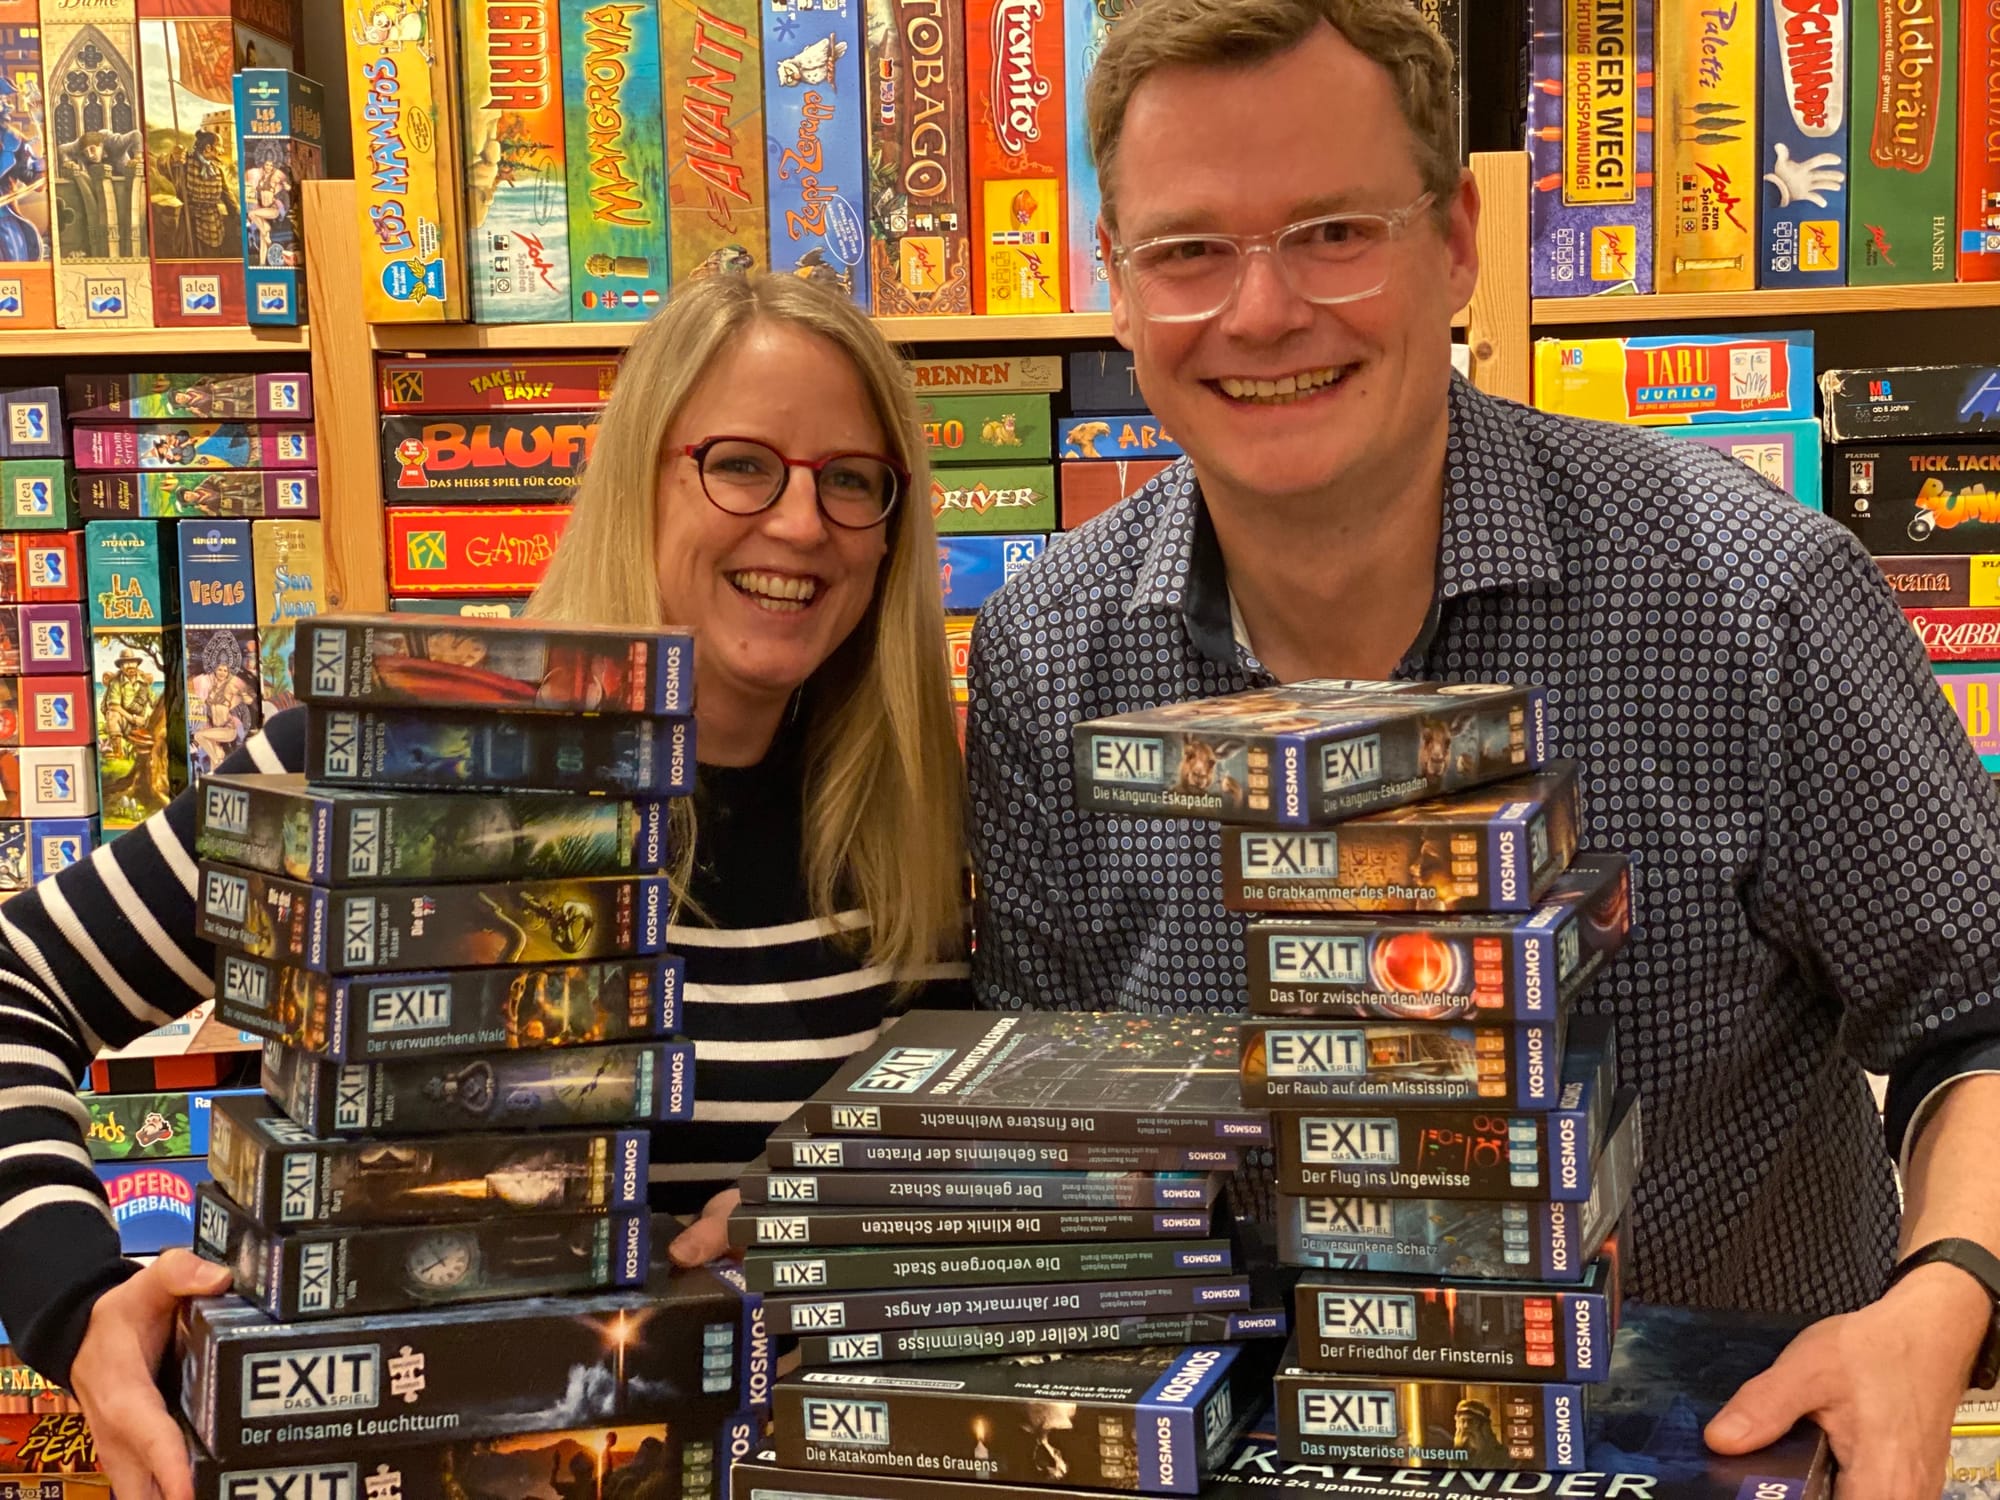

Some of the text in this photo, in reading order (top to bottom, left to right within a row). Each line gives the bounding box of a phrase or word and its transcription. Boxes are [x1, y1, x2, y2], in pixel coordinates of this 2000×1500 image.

[480, 0, 550, 109] GARA
[1700, 2, 1737, 88] Paletti
[1893, 0, 1934, 144] oldbräu
[683, 8, 752, 203] AVANTI
[1596, 0, 1623, 189] INGER WEG!
[1882, 75, 1892, 112] gewinnt
[256, 108, 275, 120] LAS
[584, 5, 650, 226] MANGROVIA
[1577, 62, 1591, 189] HOCHSPANNUNG!
[364, 57, 413, 253] LOS MAMPFOS
[779, 90, 838, 241] Zapp Zerapp
[1700, 188, 1710, 230] Spielen
[1932, 216, 1944, 271] HANSER
[91, 284, 120, 296] alea
[185, 282, 215, 293] alea
[1561, 349, 1583, 365] MB
[1644, 348, 1711, 385] TABU
[470, 369, 527, 394] TAKE IT
[915, 362, 1010, 387] RENNEN
[504, 383, 555, 401] EASY!
[1741, 389, 1786, 410] für Kinder
[1869, 381, 1891, 396] MB
[1890, 404, 1909, 412] Jahre
[18, 407, 28, 439] alea
[430, 479, 452, 488] DAS
[454, 478, 490, 487] HEISSE
[493, 478, 520, 487] SPIEL
[523, 476, 545, 486] FÜR
[1852, 463, 1862, 475] 12
[941, 487, 1036, 509] RIVER
[36, 552, 45, 583] alea
[275, 566, 313, 592] San
[112, 573, 142, 598] LA
[189, 580, 245, 606] VEGAS
[1886, 573, 1951, 591] scana
[103, 599, 153, 619] ISLA
[271, 591, 317, 624] Juan
[39, 626, 47, 656] alea
[666, 647, 680, 710] KOSMOS
[43, 696, 52, 727] alea
[671, 724, 685, 786] KOSMOS
[1096, 741, 1162, 778] EXIT
[1093, 787, 1222, 809] Die Känguru-Eskapaden
[648, 803, 659, 863] KOSMOS
[1247, 838, 1330, 874] EXIT
[1243, 886, 1436, 899] Die Grabkammer des Pharao
[647, 885, 659, 945] KOSMOS
[1275, 942, 1359, 979] EXIT
[374, 990, 446, 1024] EXIT
[664, 968, 675, 1029] KOSMOS
[1270, 989, 1470, 1009] Das Tor zwischen den Welten
[367, 1029, 506, 1053] Der verwunschene Wald
[1271, 1036, 1359, 1072] EXIT
[670, 1052, 684, 1112] KOSMOS
[1267, 1082, 1469, 1098] Der Raub auf dem Mississippi
[921, 1113, 1094, 1131] Die finstere Weihnacht
[1306, 1123, 1392, 1159] EXIT
[867, 1147, 1068, 1162] Das Geheimnis der Piraten
[623, 1139, 637, 1201] KOSMOS
[1302, 1171, 1470, 1189] Der Flug ins Ungewisse
[889, 1183, 1042, 1198] Der geheime Schatz
[862, 1219, 1040, 1233] Die Klinik der Schatten
[1302, 1238, 1438, 1256] Der versunkene Schatz
[893, 1257, 1061, 1275] Die verborgene Stadt
[885, 1295, 1080, 1318] Der Jahrmarkt der Angst
[898, 1324, 1120, 1350] Der Keller der Geheimnisse
[1320, 1345, 1513, 1365] Der Friedhof der Finsternis
[252, 1353, 372, 1406] EXIT
[284, 1394, 370, 1409] DAS SPIEL
[242, 1414, 459, 1444] Der einsame Leuchtturm
[808, 1404, 883, 1439] EXIT
[806, 1447, 998, 1472] Die Katakomben des Grauens
[1301, 1442, 1468, 1460] Das mysteriöse Museum
[16, 1489, 41, 1498] vor
[44, 1486, 60, 1497] 12
[1284, 1479, 1311, 1488] 24
[1314, 1482, 1439, 1500] spannenden
